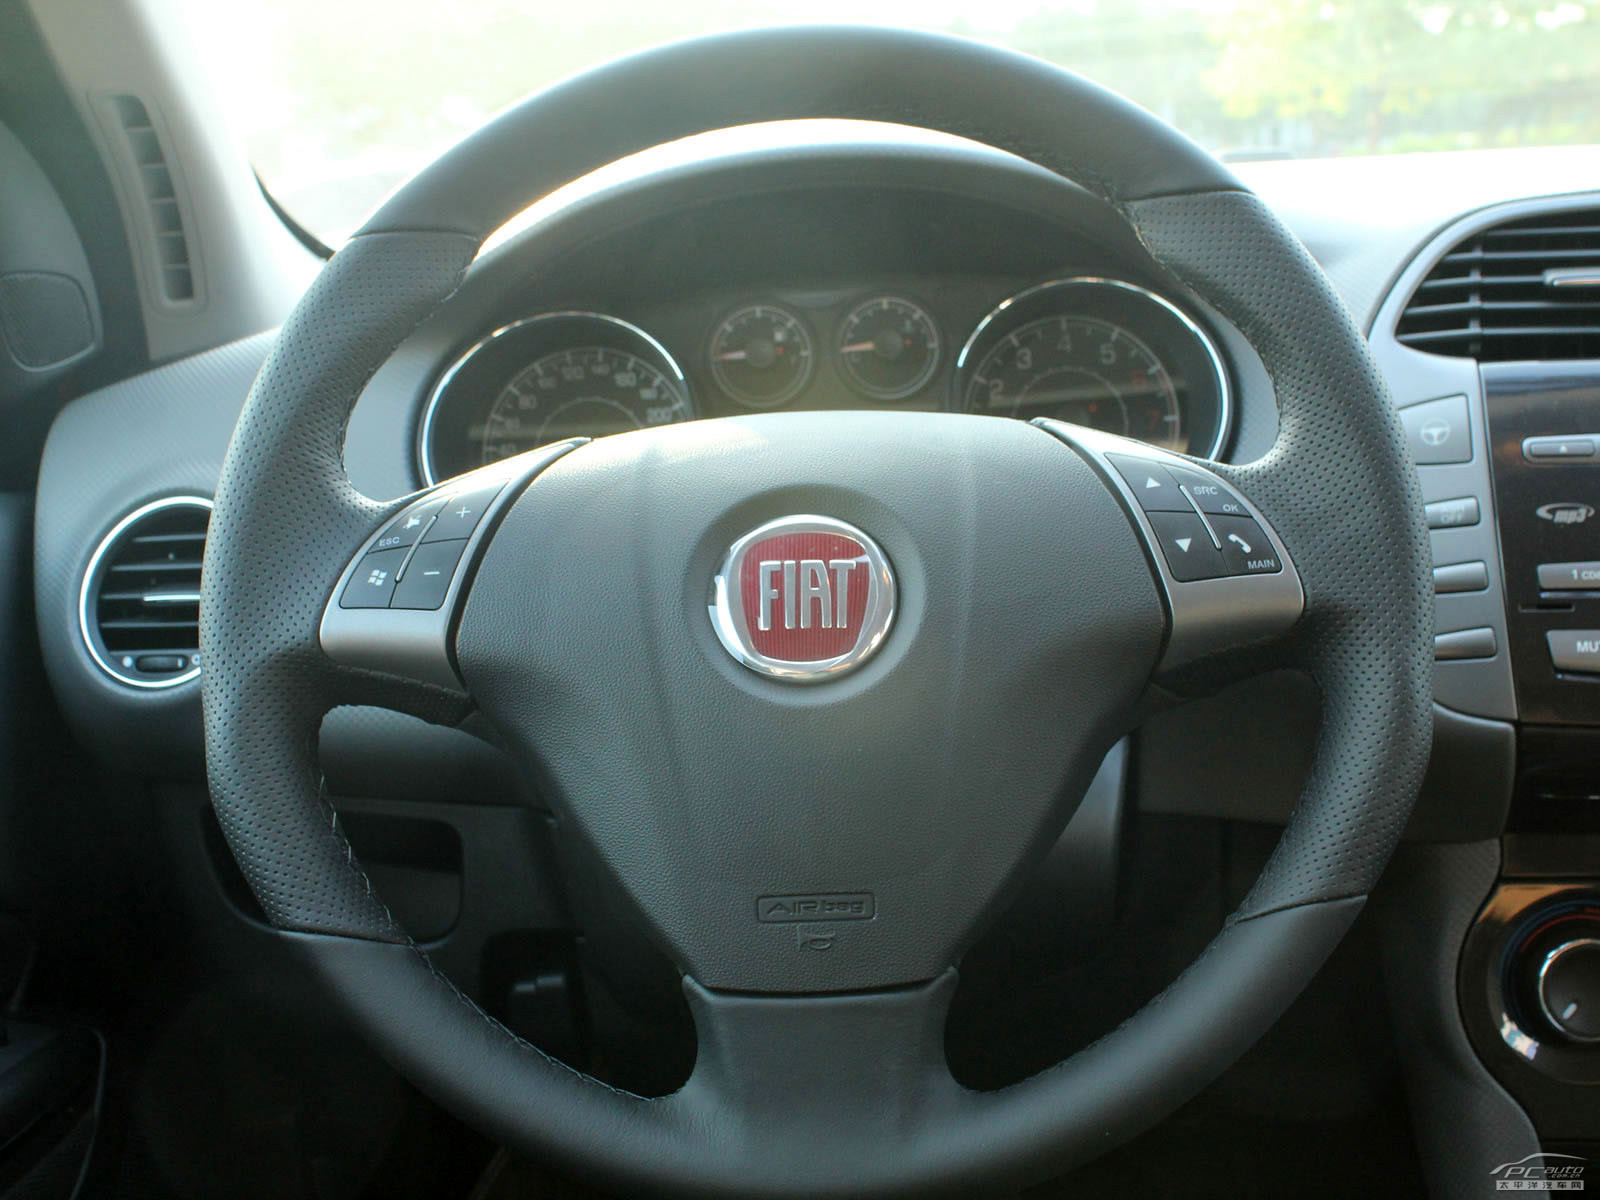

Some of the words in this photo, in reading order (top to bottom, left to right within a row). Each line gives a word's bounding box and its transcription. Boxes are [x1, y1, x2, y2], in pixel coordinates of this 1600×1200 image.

[1057, 332, 1073, 353] 4
[1016, 346, 1032, 370] 3
[1100, 343, 1117, 365] 5
[990, 379, 1004, 401] 2
[646, 407, 674, 423] 200
[1193, 486, 1218, 496] SRC
[1222, 503, 1239, 512] OK
[1553, 508, 1587, 524] mp3
[378, 536, 401, 547] ESC
[1247, 559, 1275, 570] MAIN
[757, 559, 857, 632] FIAT
[1576, 639, 1600, 653] MU
[766, 901, 819, 914] AIR
